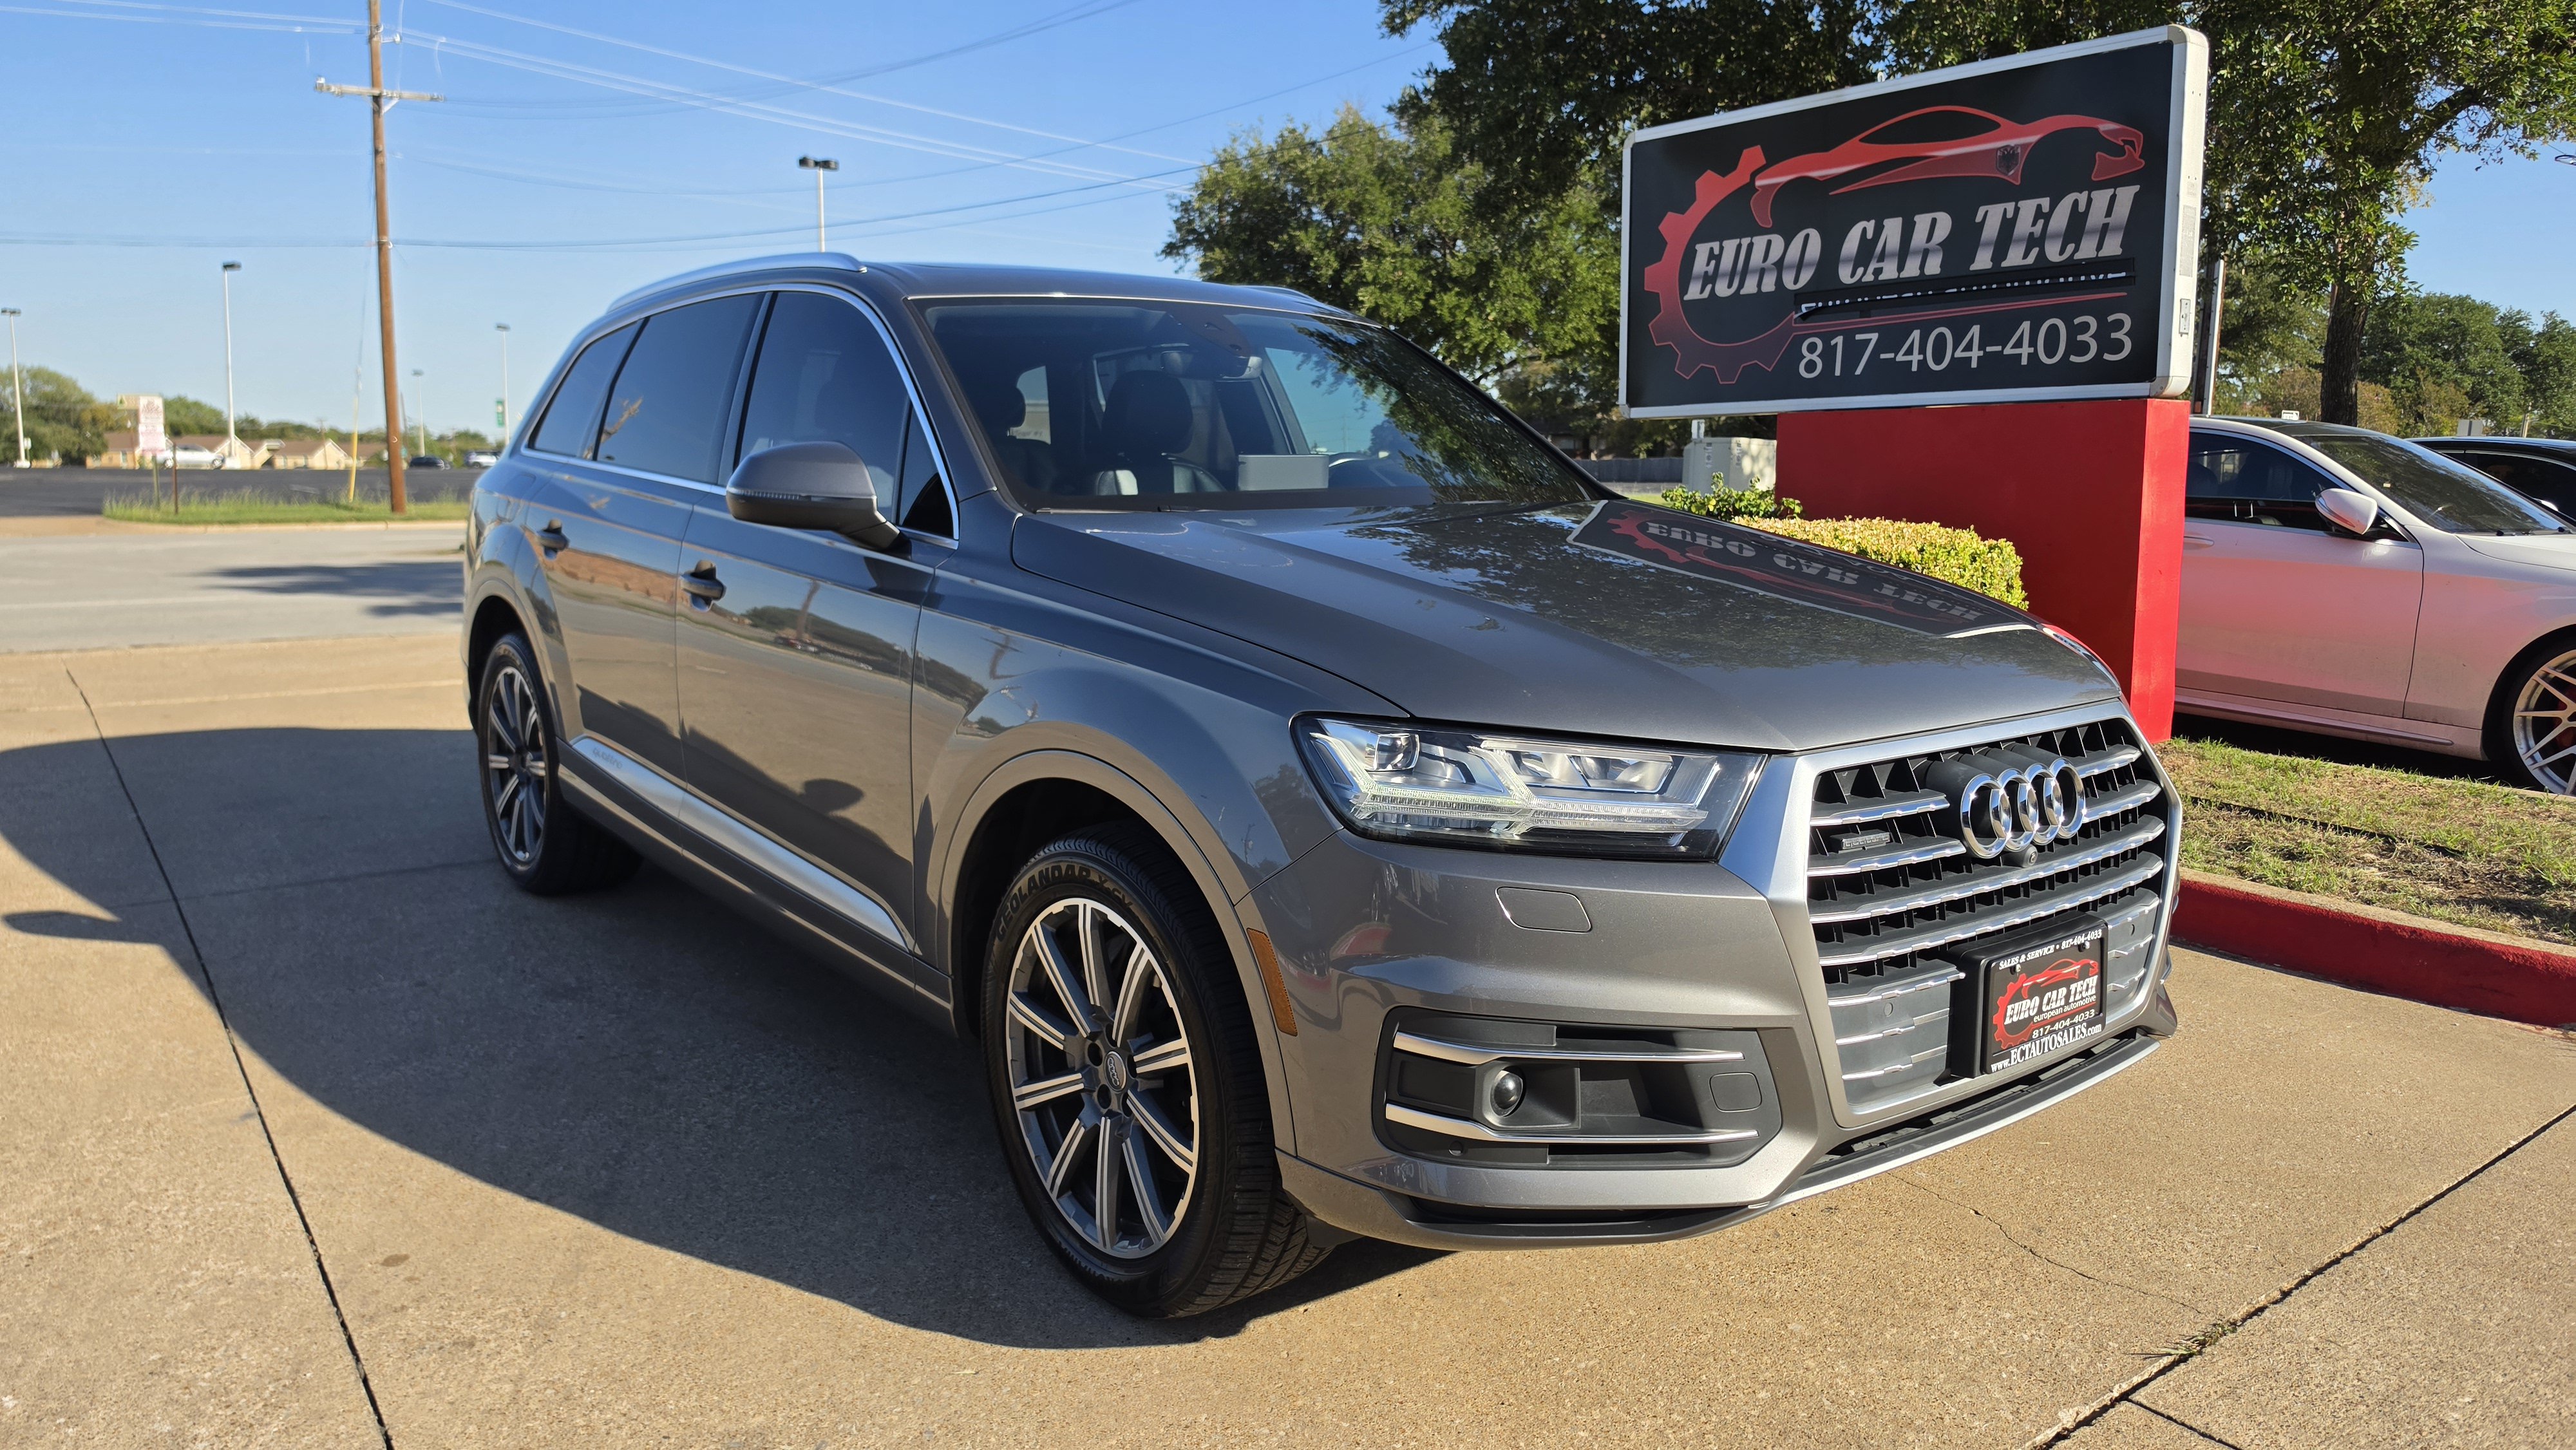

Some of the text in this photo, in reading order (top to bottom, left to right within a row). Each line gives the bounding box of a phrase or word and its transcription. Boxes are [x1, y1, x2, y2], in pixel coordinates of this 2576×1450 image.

[1683, 227, 1822, 301] EURO
[1837, 211, 1953, 284] CAR
[1969, 185, 2141, 270] TECH
[1799, 312, 2132, 379] 817-404-4033
[997, 864, 1091, 942] GEOLANDAR
[1999, 928, 2102, 970] SALES & SERVICE 817-404-4033
[2004, 975, 2098, 1025] EURO CAR TECH
[2032, 1009, 2095, 1039] 817-404-4033
[2033, 995, 2096, 1022] european automotive
[1991, 1023, 2102, 1073] www.ECTAUTOSALES.com
